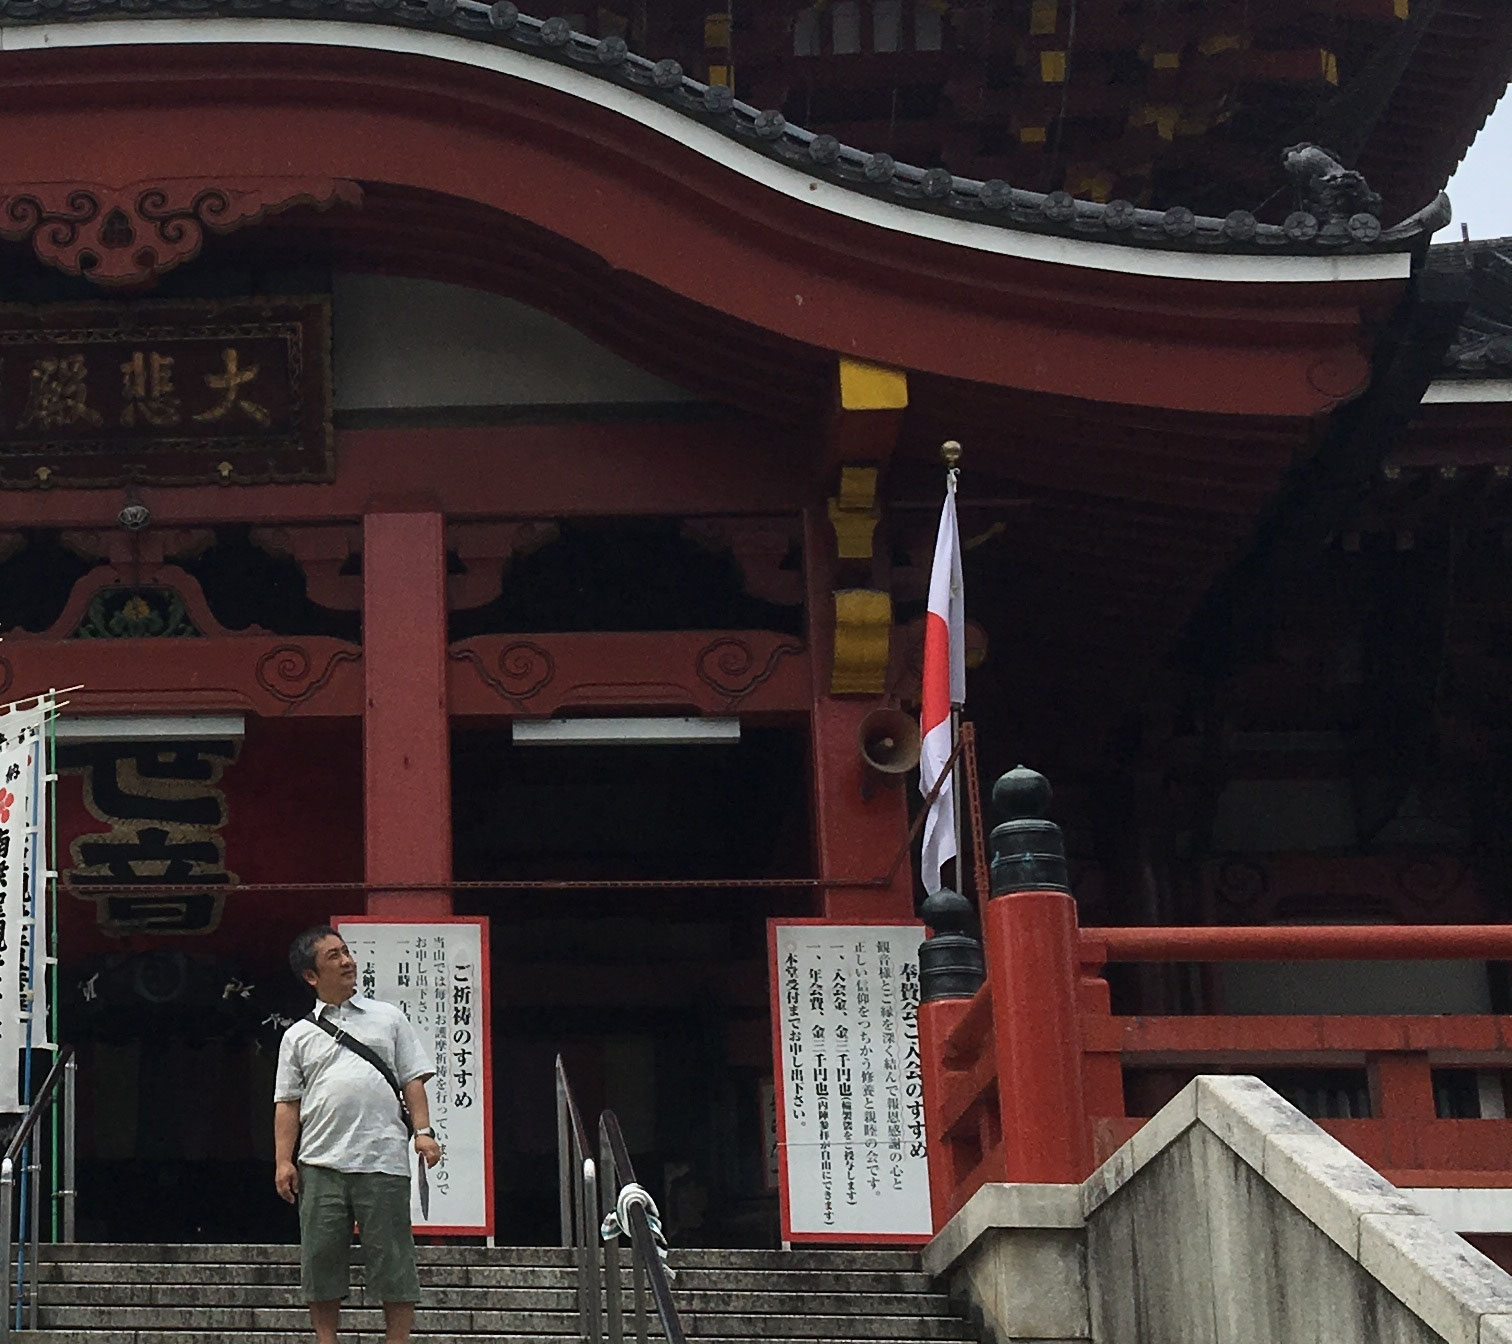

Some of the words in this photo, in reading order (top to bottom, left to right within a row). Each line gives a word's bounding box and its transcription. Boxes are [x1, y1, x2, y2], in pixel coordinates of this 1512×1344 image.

[453, 964, 473, 1108] ご祈祷のすすめ
